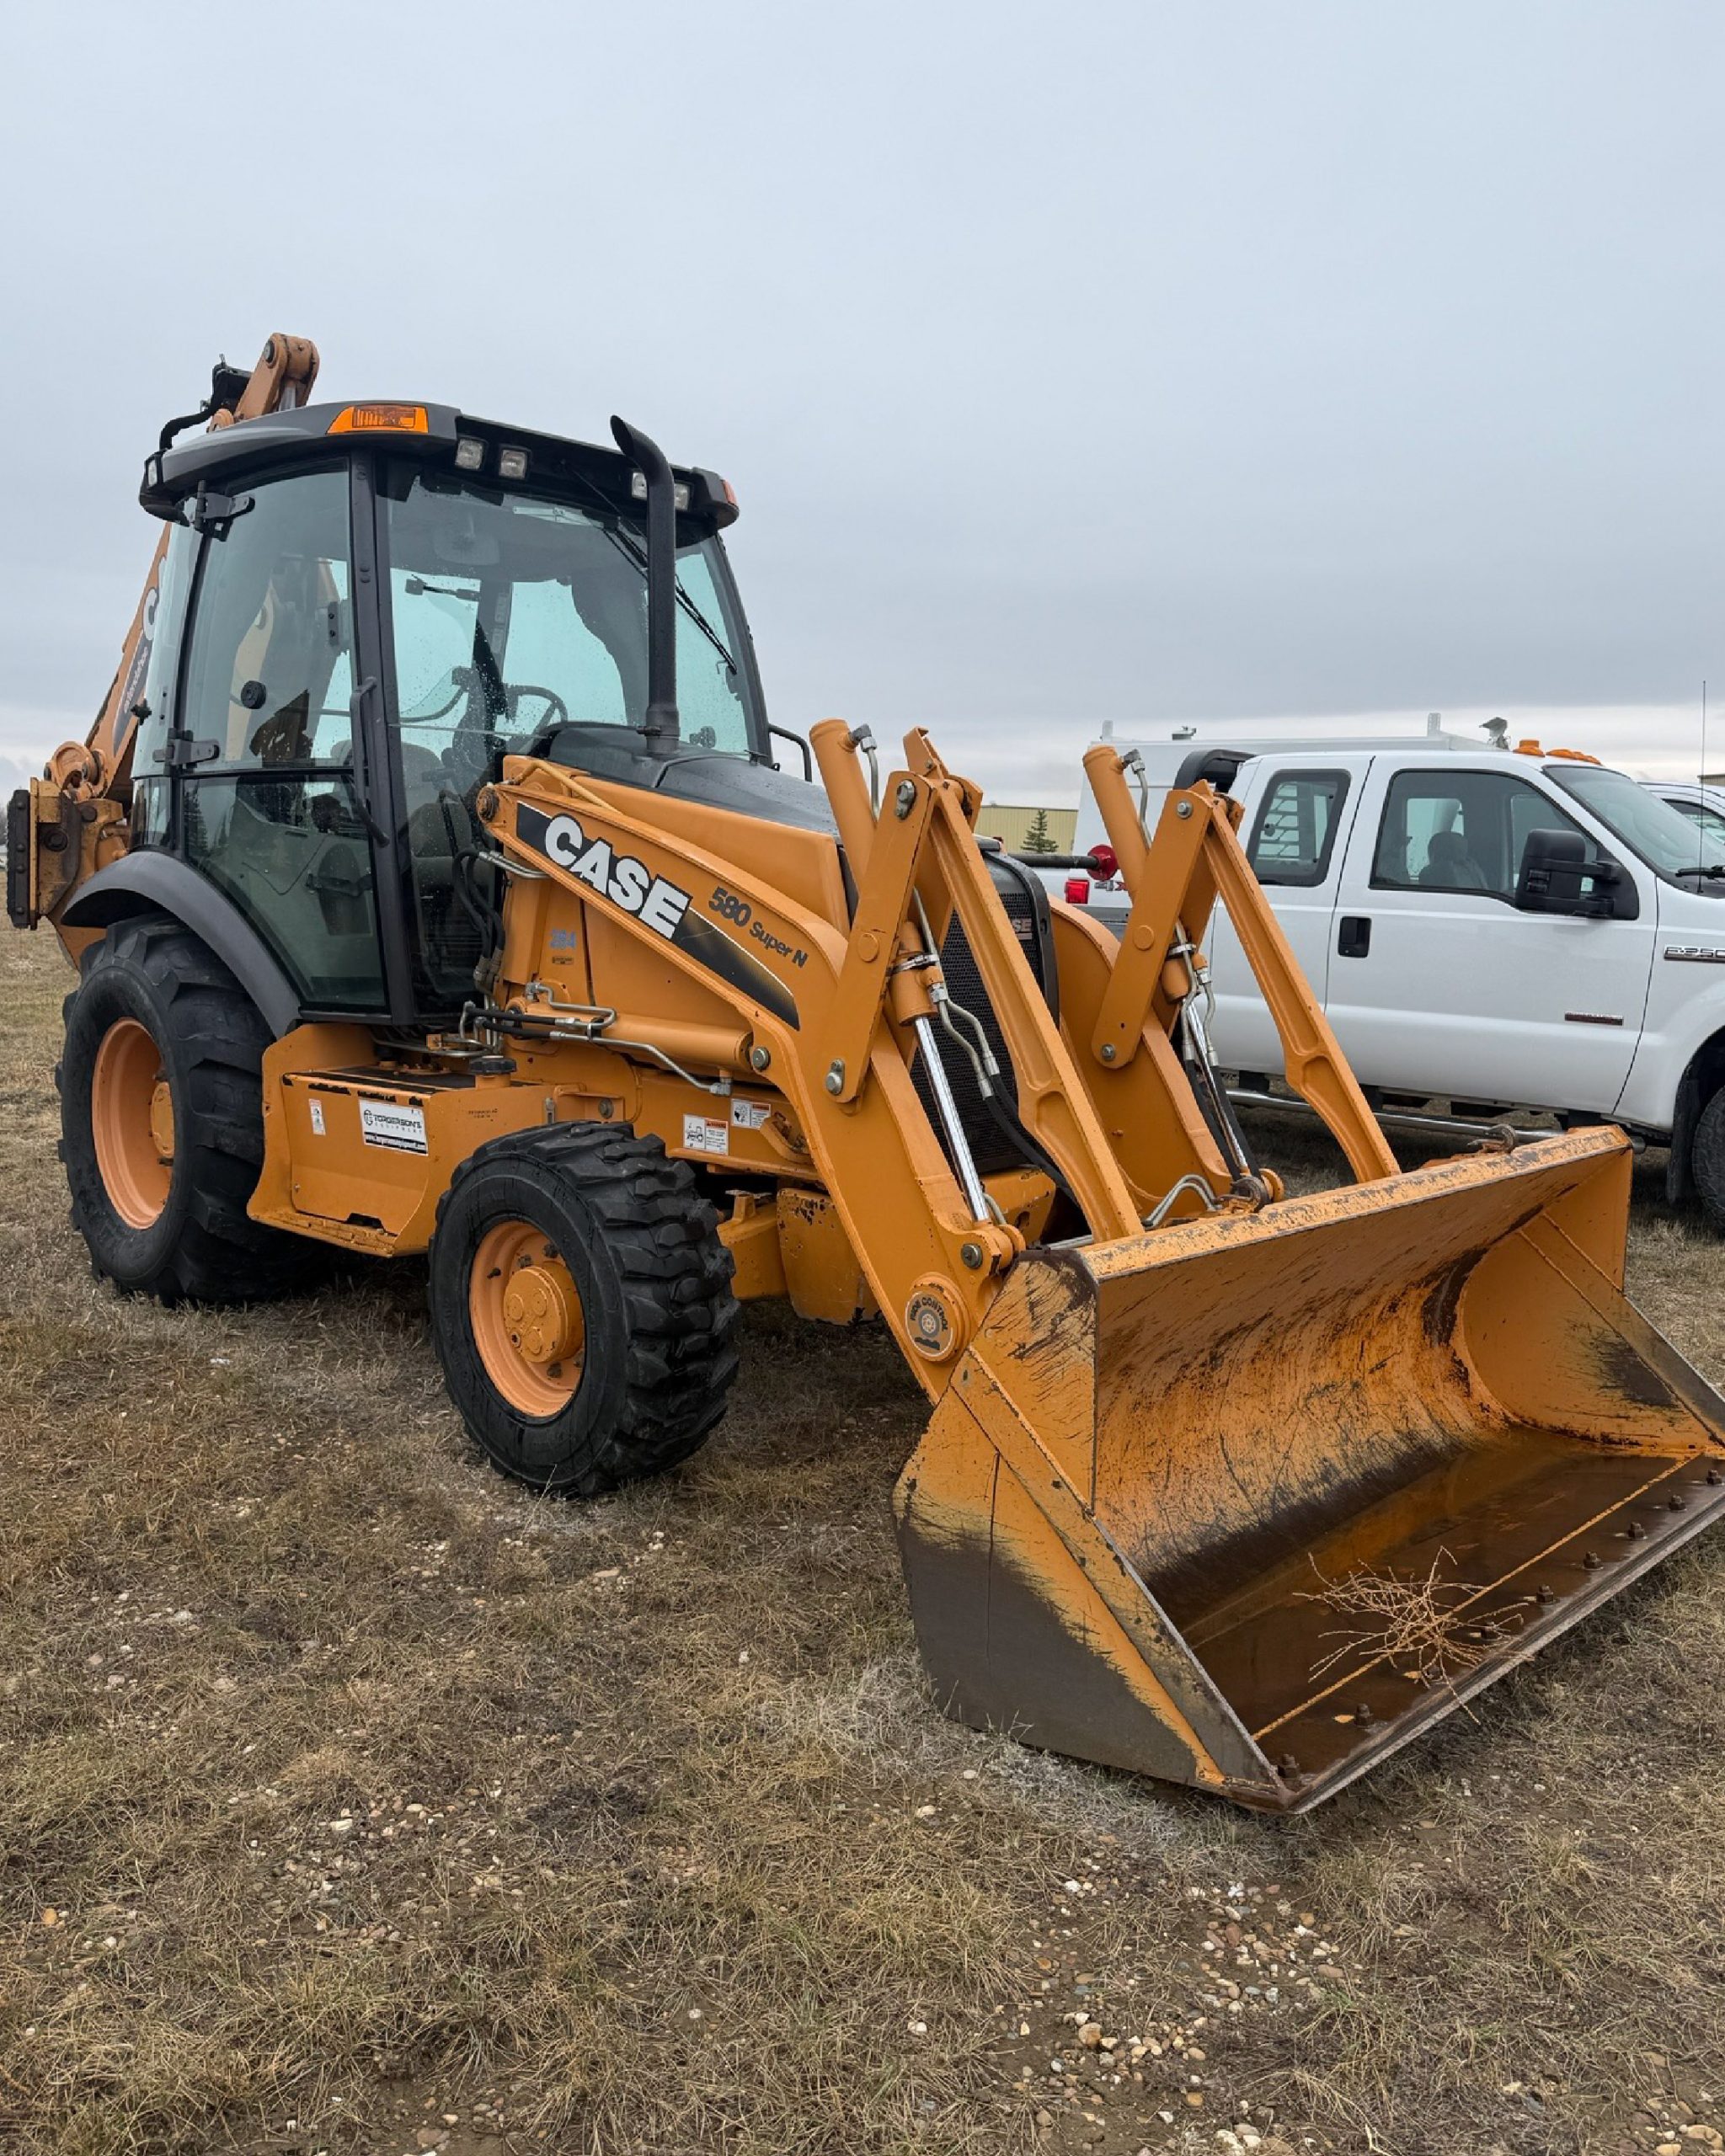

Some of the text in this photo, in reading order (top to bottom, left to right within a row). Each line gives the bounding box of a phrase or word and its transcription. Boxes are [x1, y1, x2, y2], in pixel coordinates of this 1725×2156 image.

[544, 814, 692, 940] CASE
[708, 887, 809, 969] 580 Super N
